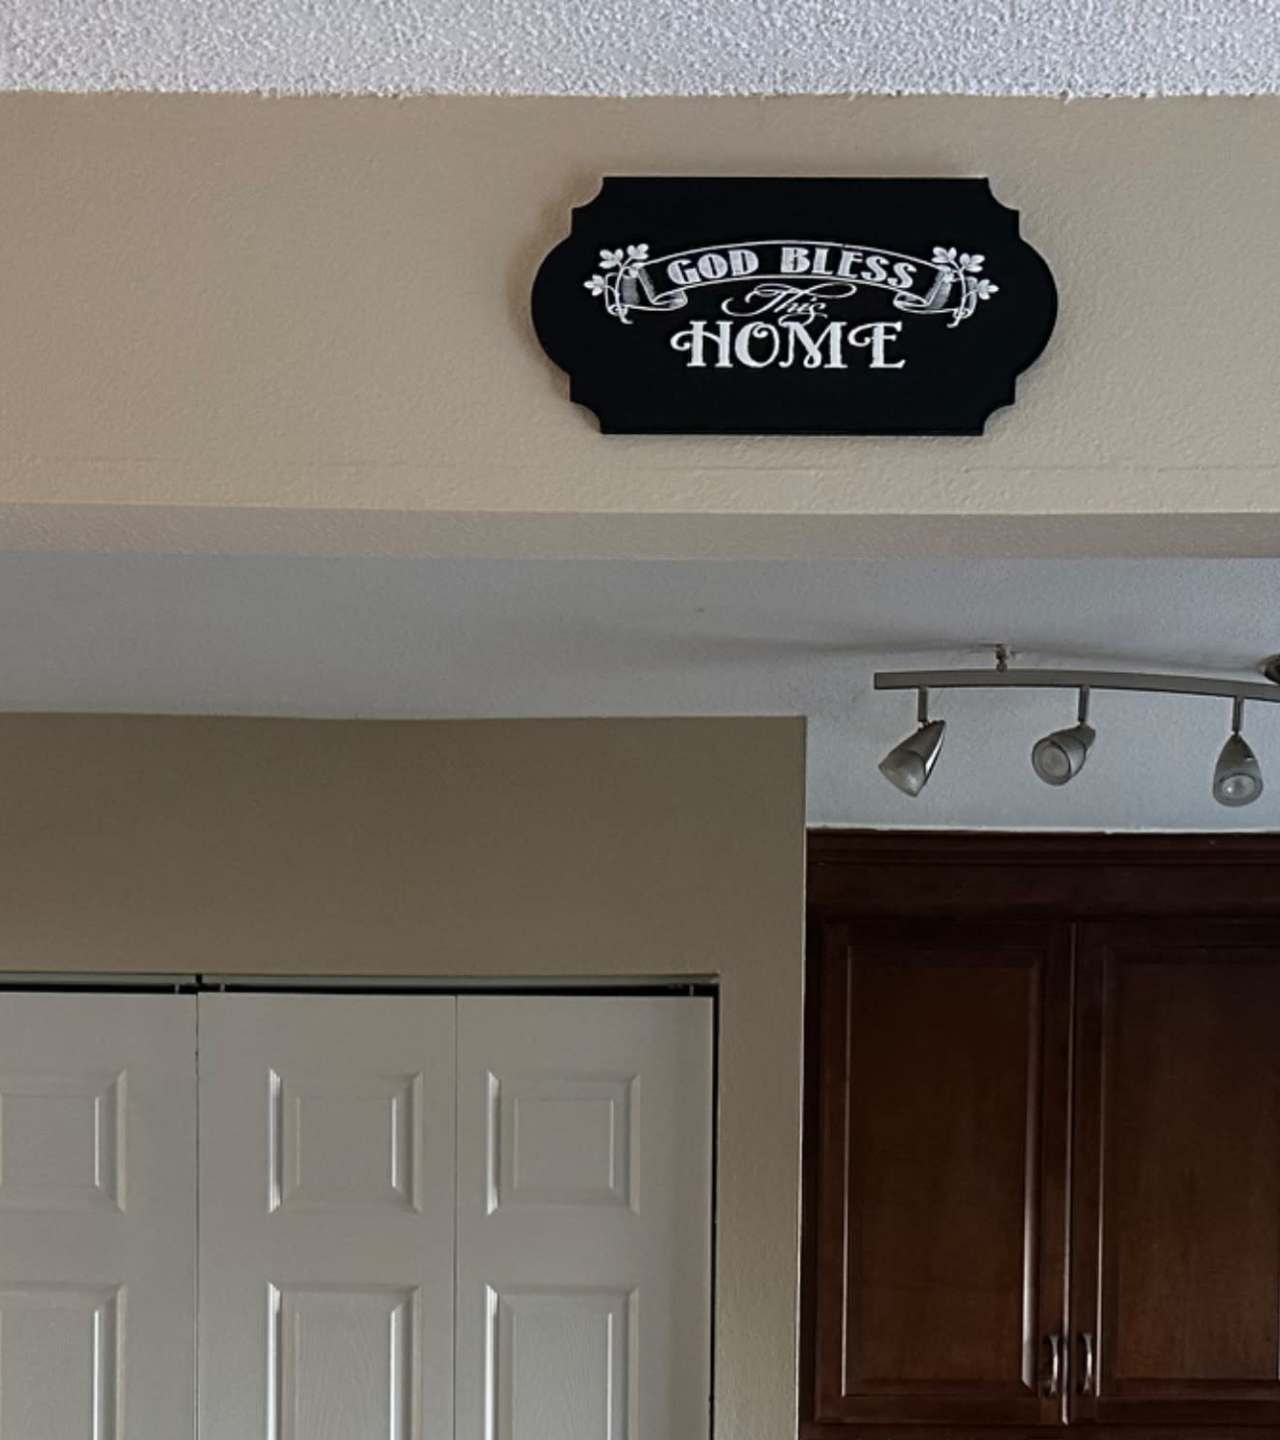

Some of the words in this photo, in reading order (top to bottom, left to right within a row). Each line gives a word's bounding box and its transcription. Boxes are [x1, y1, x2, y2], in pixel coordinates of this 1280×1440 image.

[666, 248, 759, 286] GOD
[780, 246, 917, 289] BLESS
[722, 283, 857, 328] This
[670, 320, 906, 369] HOME
